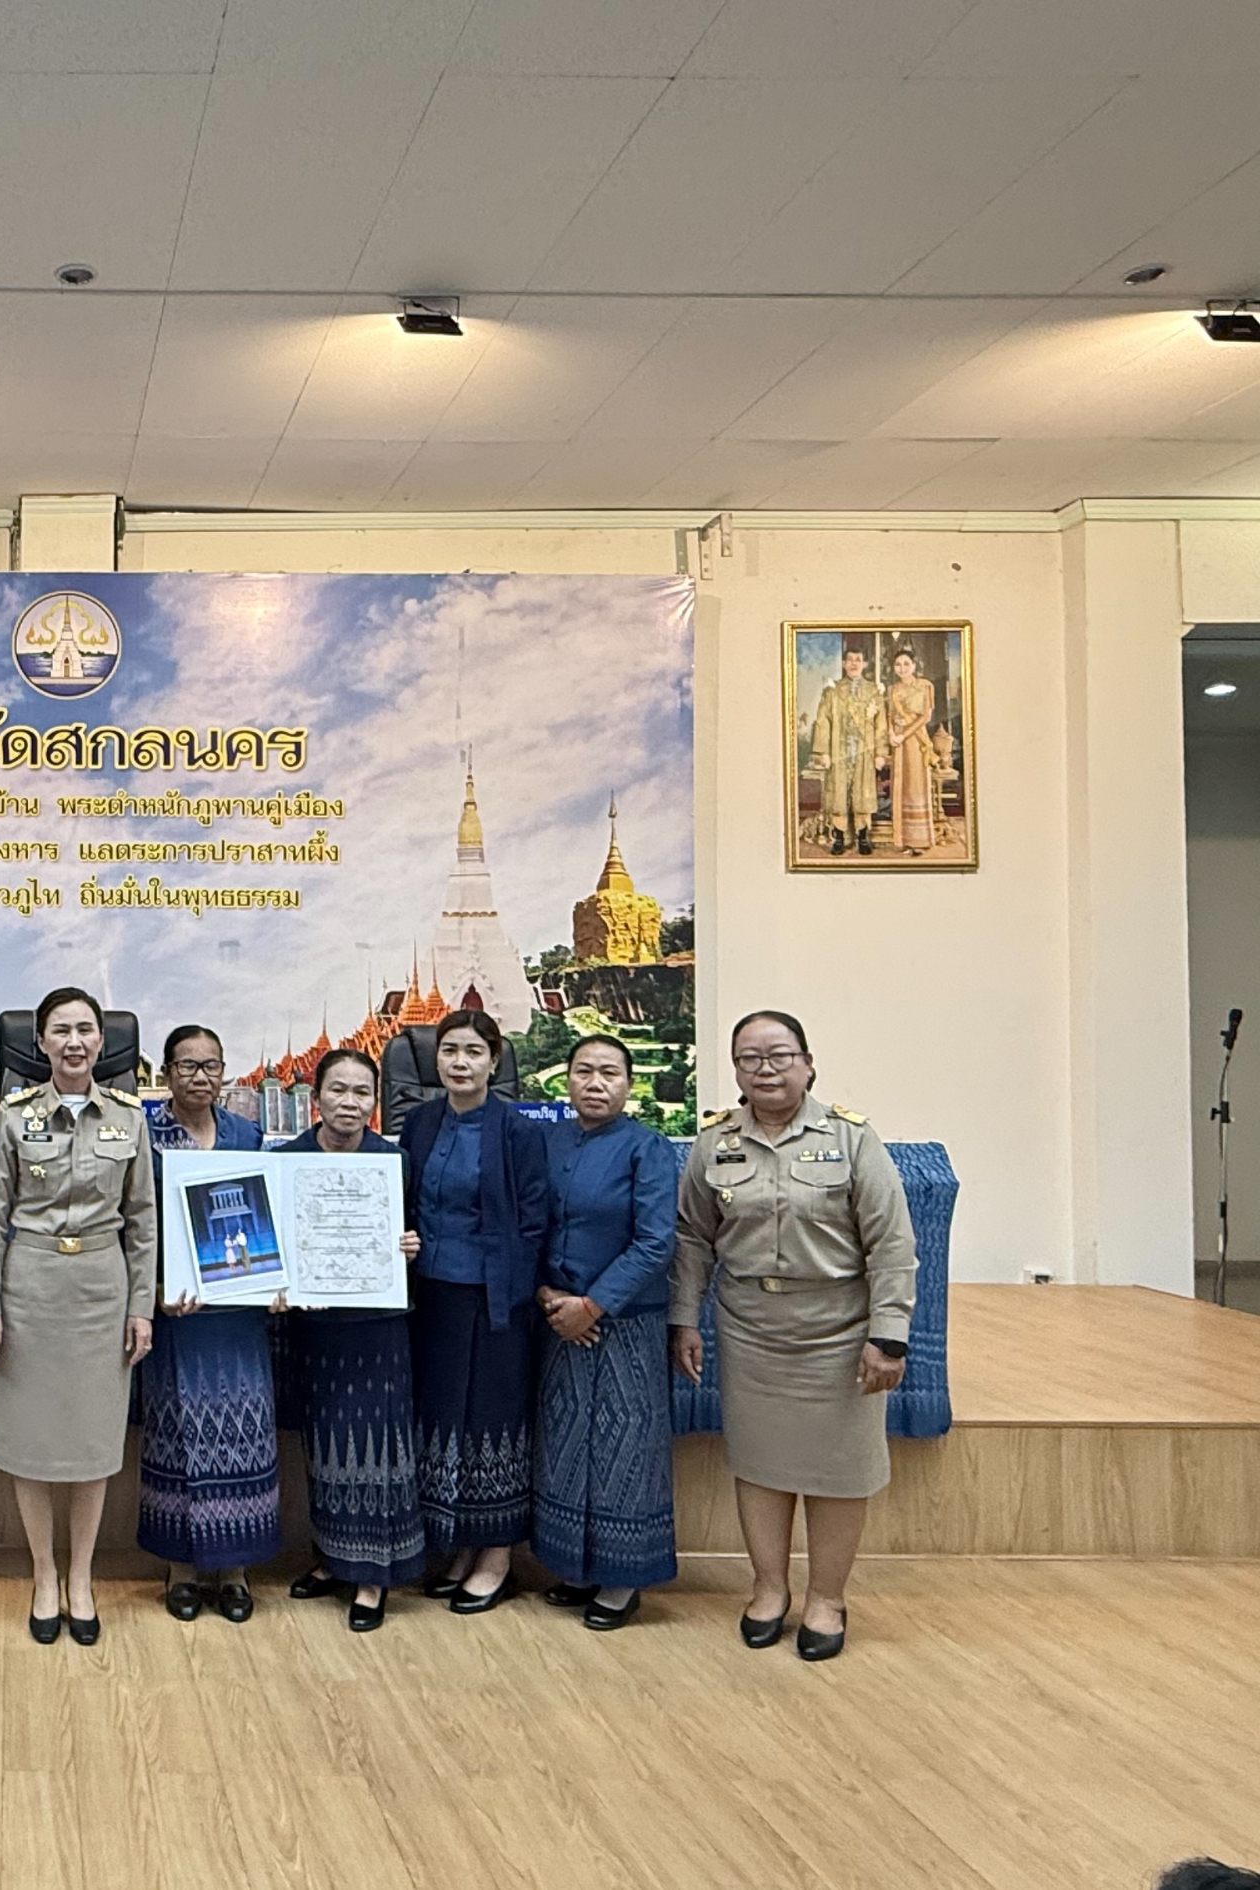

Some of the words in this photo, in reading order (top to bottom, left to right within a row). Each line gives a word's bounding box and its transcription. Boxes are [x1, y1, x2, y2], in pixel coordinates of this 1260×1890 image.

[57, 790, 343, 826] พระตำหนักภูพานคู่เมือง
[79, 830, 339, 862] แลตระการปราสาทผึ้ง
[79, 875, 300, 917] ถิ่นมั่นในพุทธธรรม
